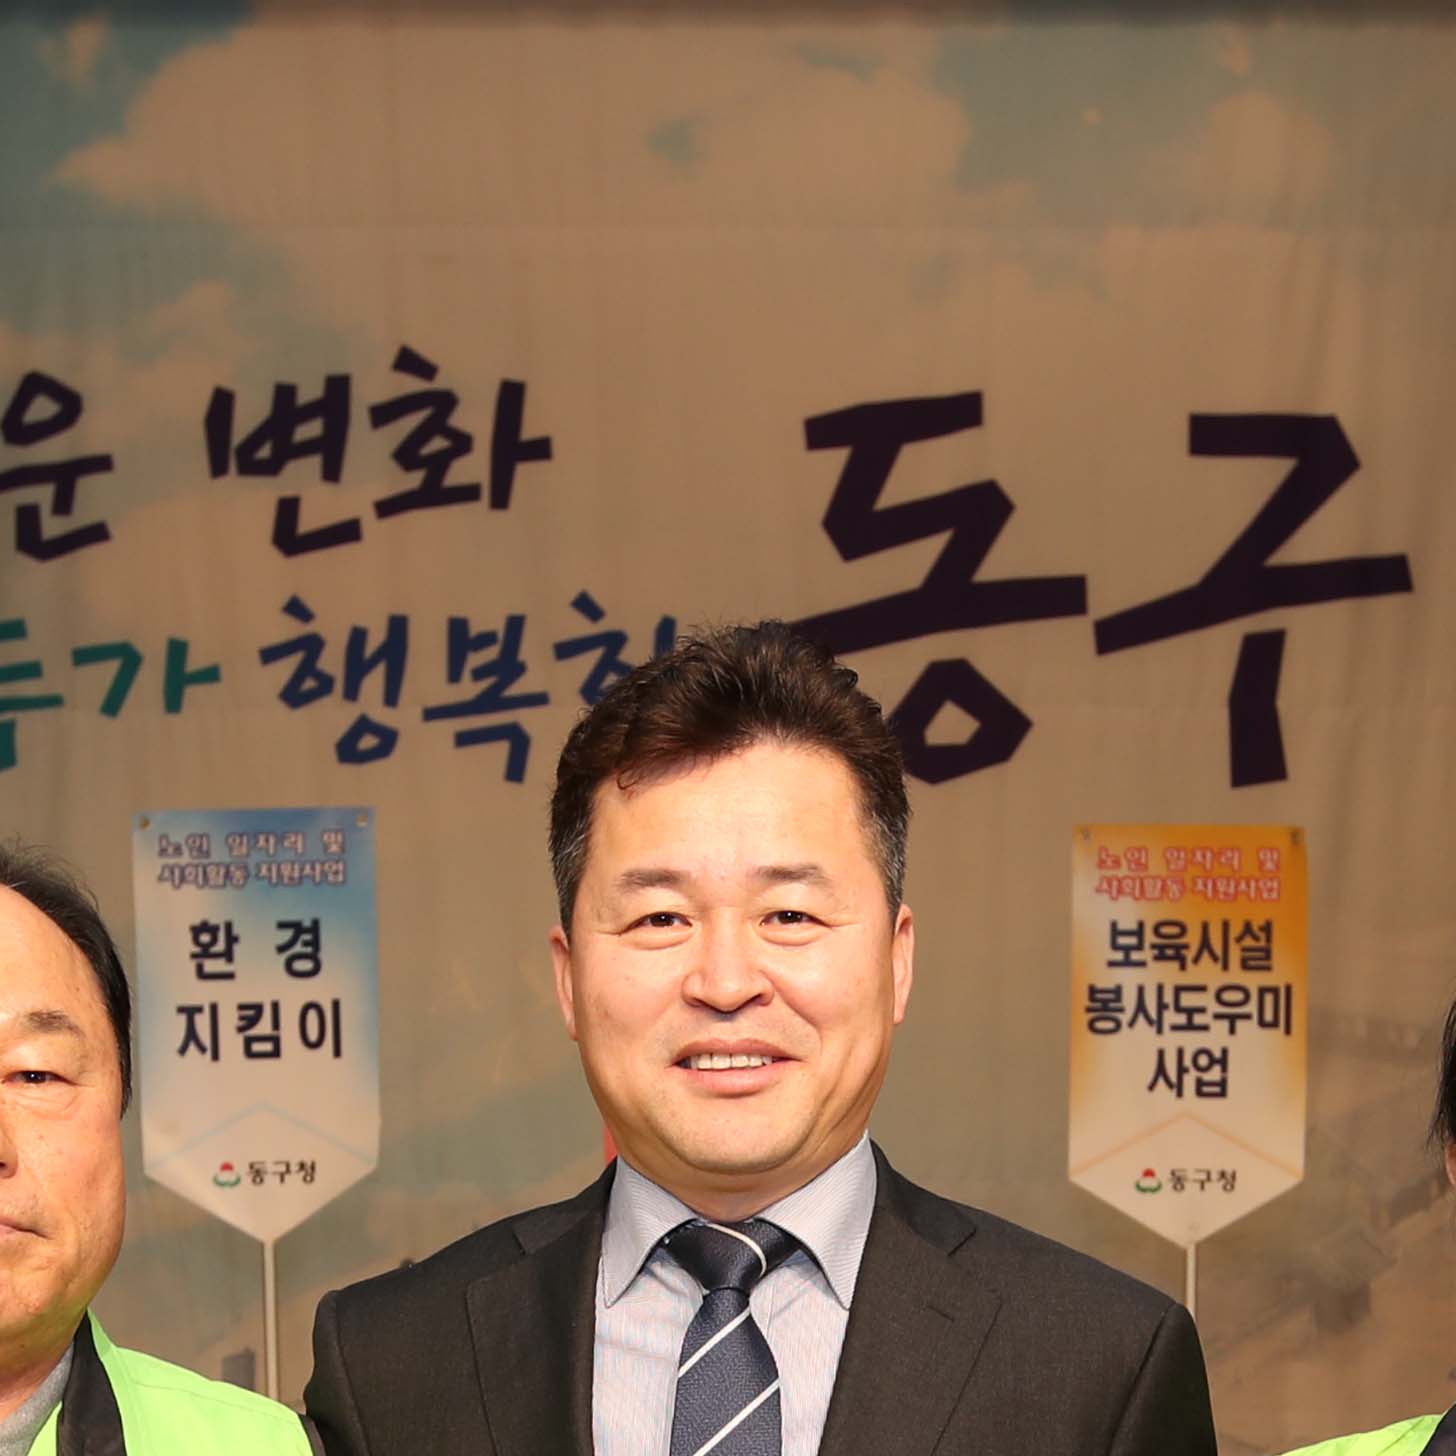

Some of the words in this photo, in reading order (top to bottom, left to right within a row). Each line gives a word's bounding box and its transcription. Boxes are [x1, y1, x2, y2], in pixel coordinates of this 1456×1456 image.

[203, 344, 552, 559] 변화
[744, 390, 1414, 788] 동구
[157, 832, 211, 859] 노인
[225, 831, 306, 856] 일자리
[321, 830, 346, 856] 및
[1096, 847, 1149, 872] 노인
[1165, 846, 1242, 873] 일자리
[1257, 847, 1281, 873] 및
[157, 861, 249, 888] 사회활동
[254, 859, 347, 885] 지원사업
[1095, 876, 1186, 902] 사회활동
[1192, 876, 1282, 901] 지원사업
[1106, 918, 1275, 973] 보육시설
[176, 998, 343, 1062] 지킴이
[1084, 983, 1294, 1037] 봉사도우미
[1147, 1046, 1230, 1099] 사업
[247, 1160, 318, 1186] 동구청
[1168, 1168, 1237, 1193] 동구청
